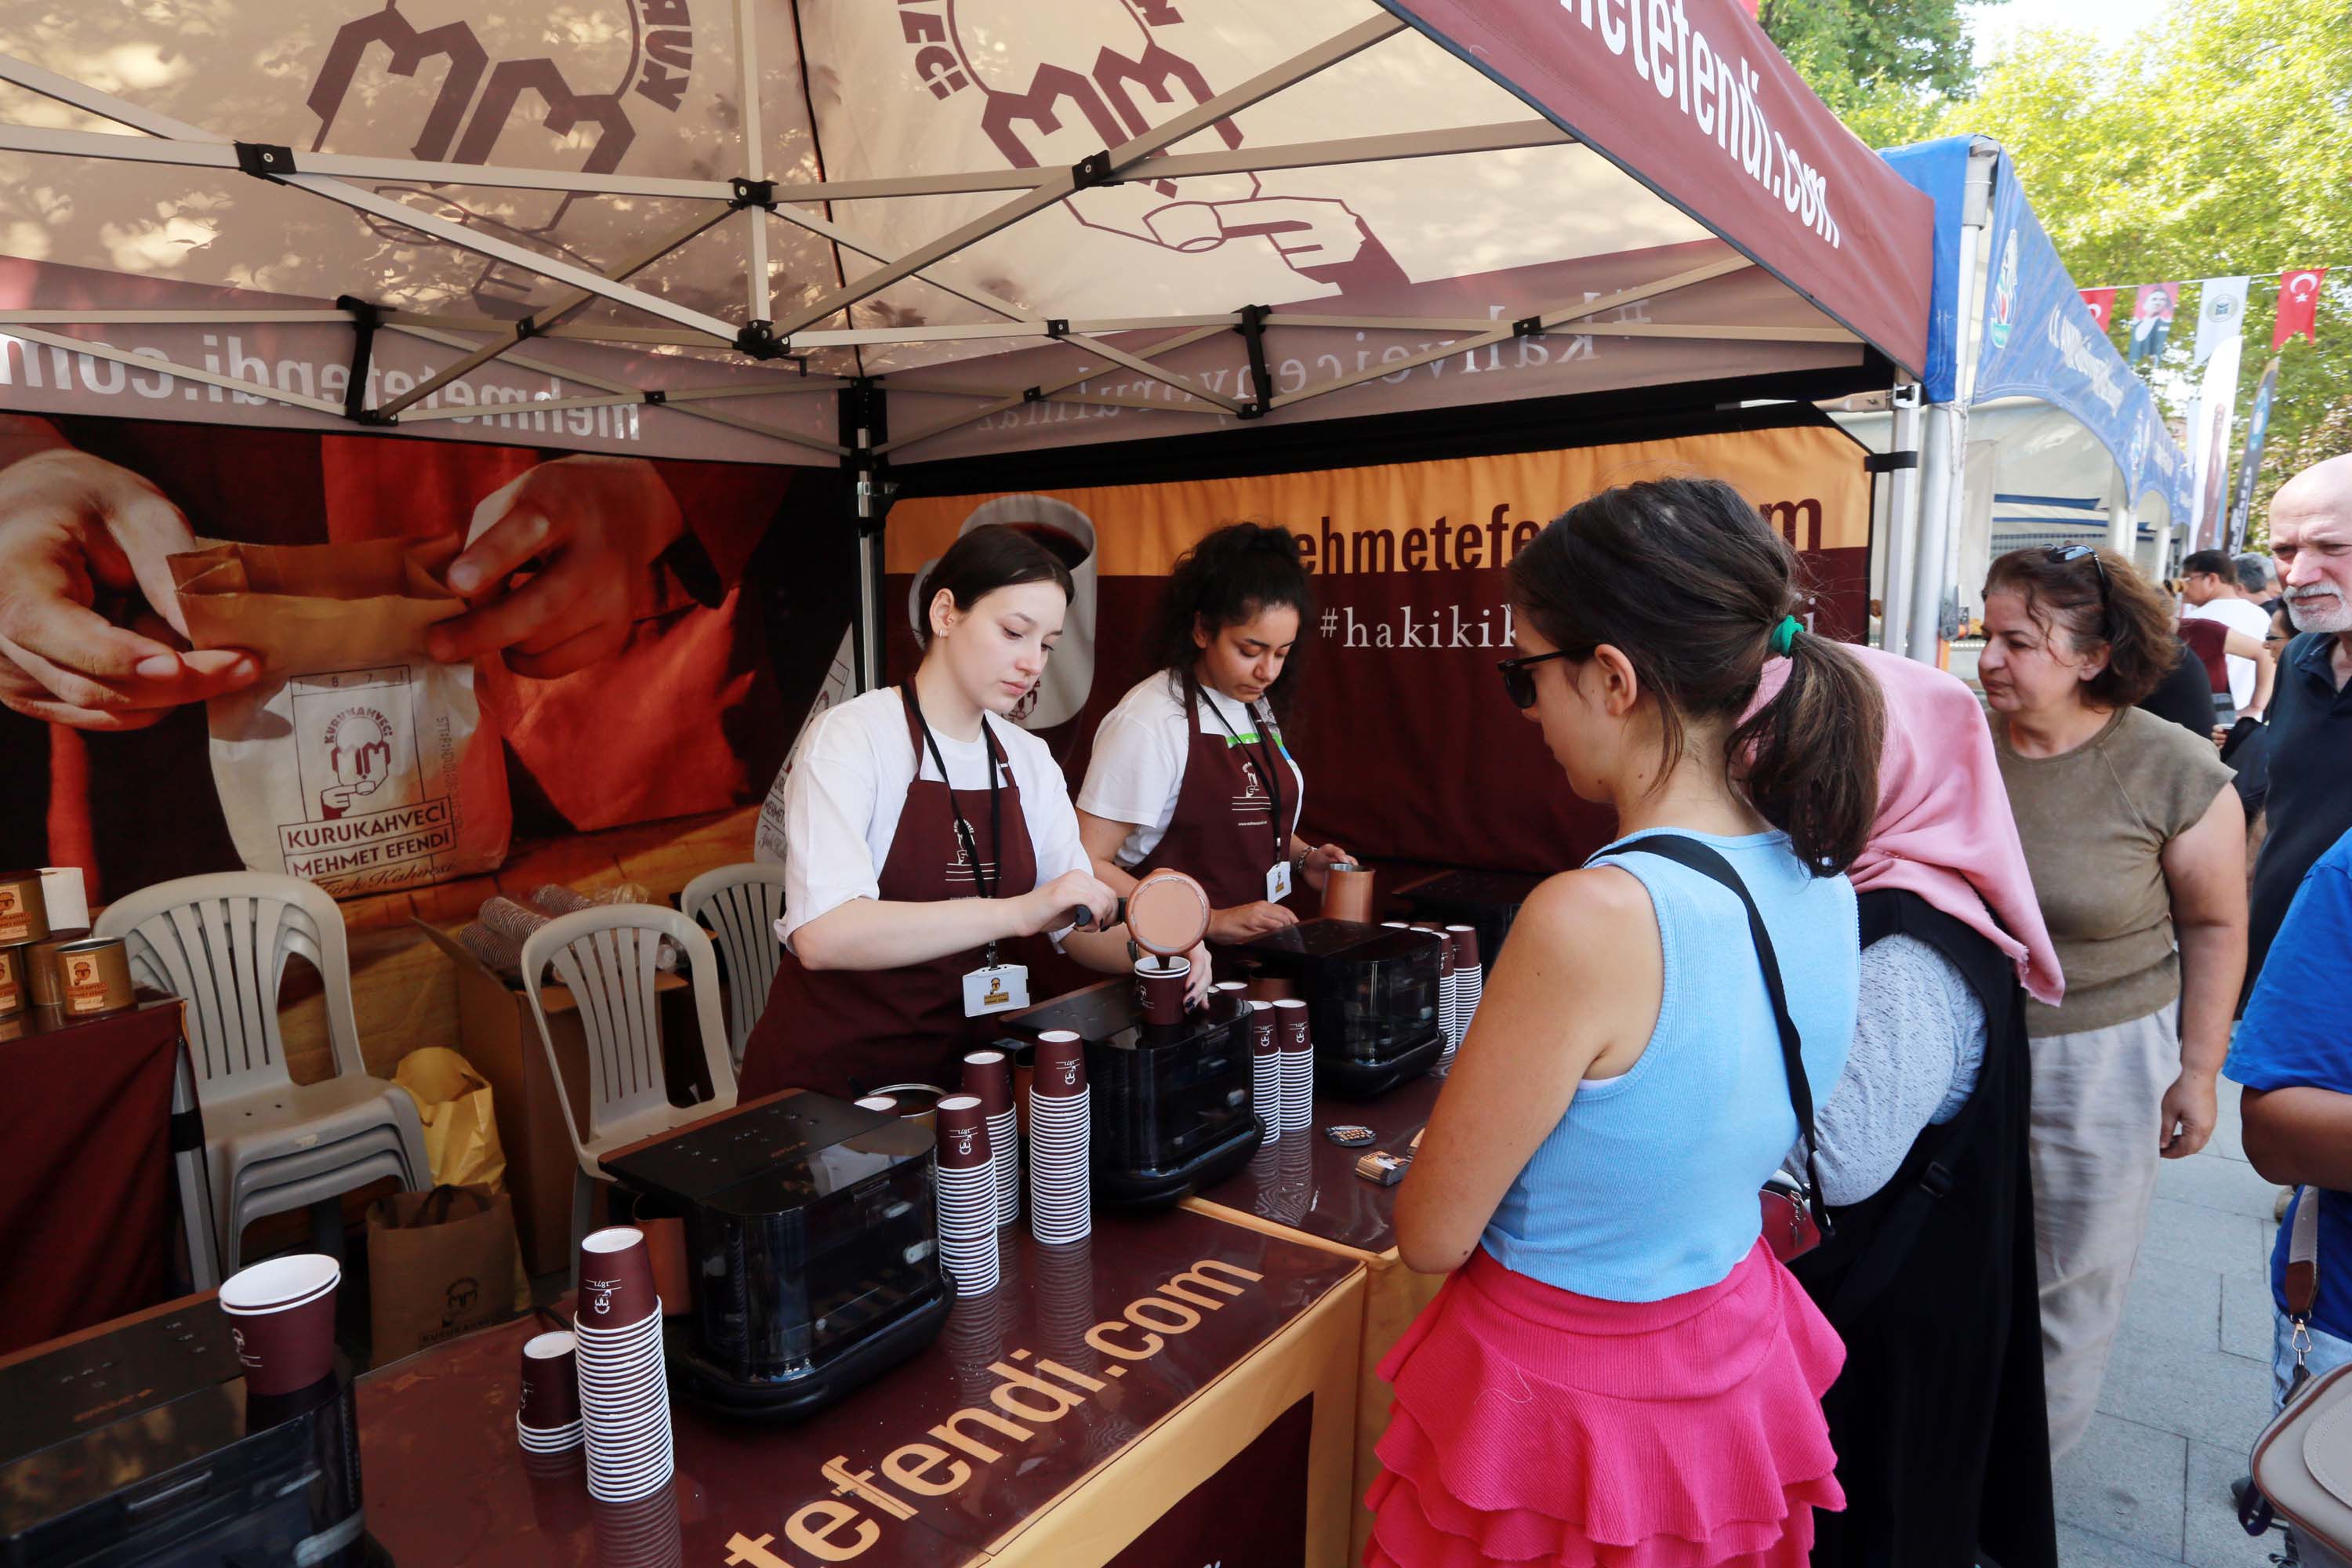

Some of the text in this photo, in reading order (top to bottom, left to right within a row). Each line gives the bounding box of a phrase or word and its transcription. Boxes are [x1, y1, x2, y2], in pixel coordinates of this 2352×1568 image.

[1560, 0, 1840, 249] etefendi.com
[288, 800, 446, 849] KURUKAHVECİ
[293, 848, 379, 877] MEHMET
[594, 1279, 610, 1288] 1871
